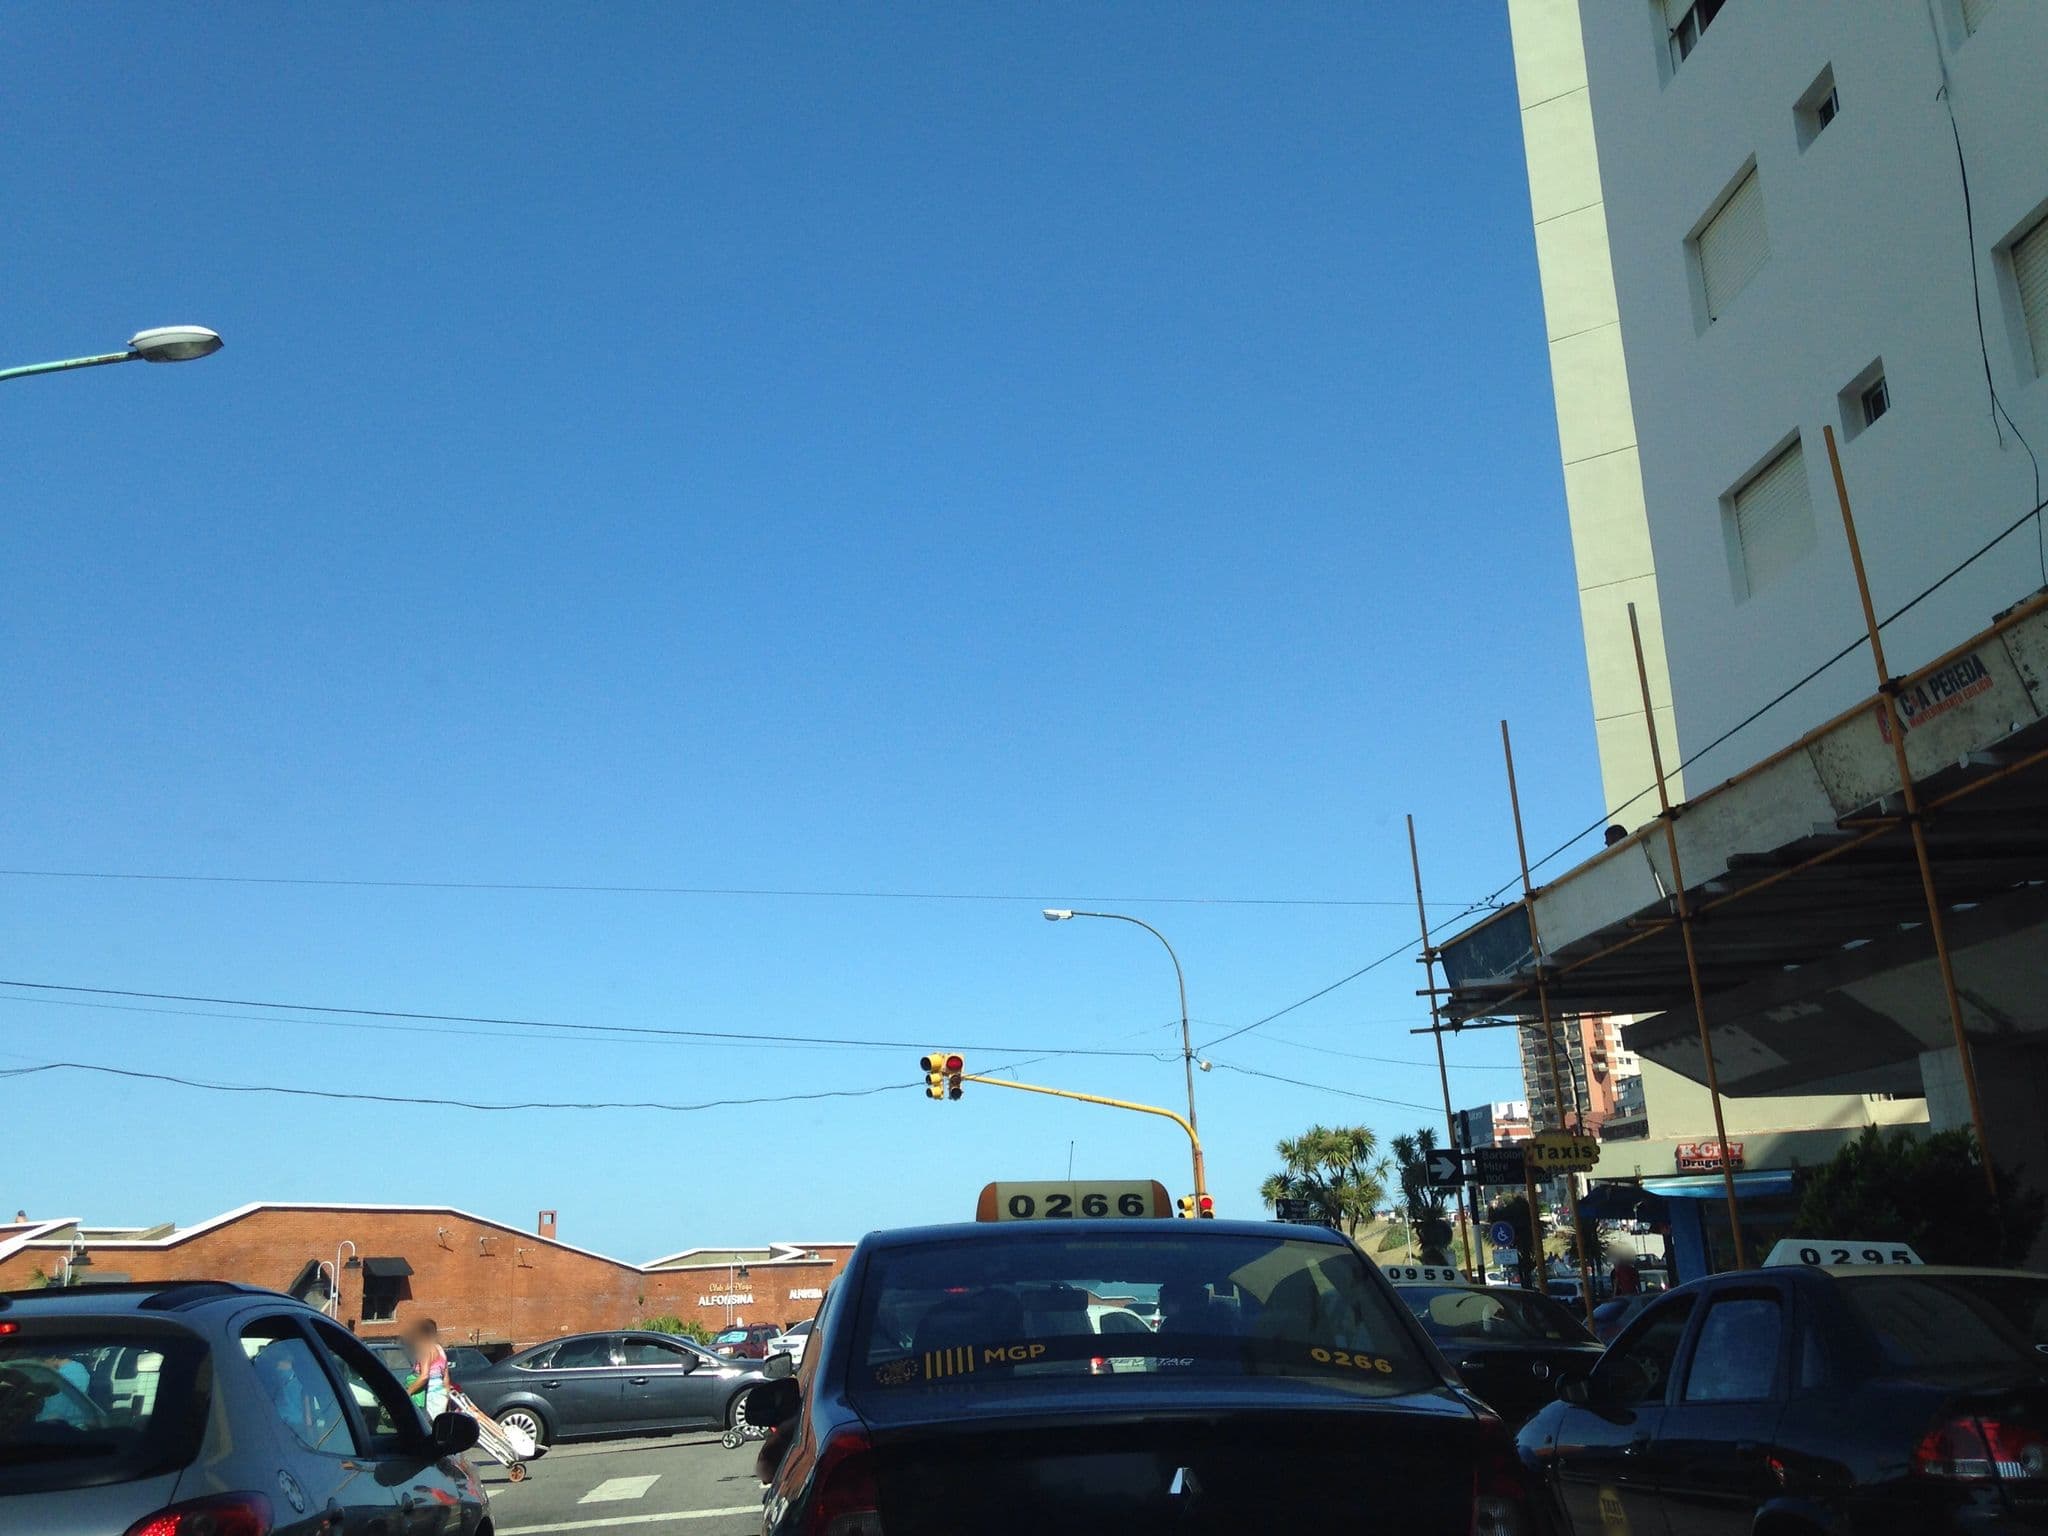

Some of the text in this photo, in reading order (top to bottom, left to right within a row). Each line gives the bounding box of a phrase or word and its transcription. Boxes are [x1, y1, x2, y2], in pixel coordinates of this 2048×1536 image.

[1928, 654, 1989, 701] PEREDA
[1535, 1143, 1591, 1160] Taxis
[1682, 1158, 1743, 1169] Drugstre
[1008, 1193, 1145, 1218] 0266
[1800, 1248, 1911, 1265] 0295
[1389, 1267, 1455, 1281] 0959
[698, 1294, 754, 1306] ALFONSINA
[983, 1344, 1047, 1364] MGP
[1310, 1347, 1393, 1374] 0266
